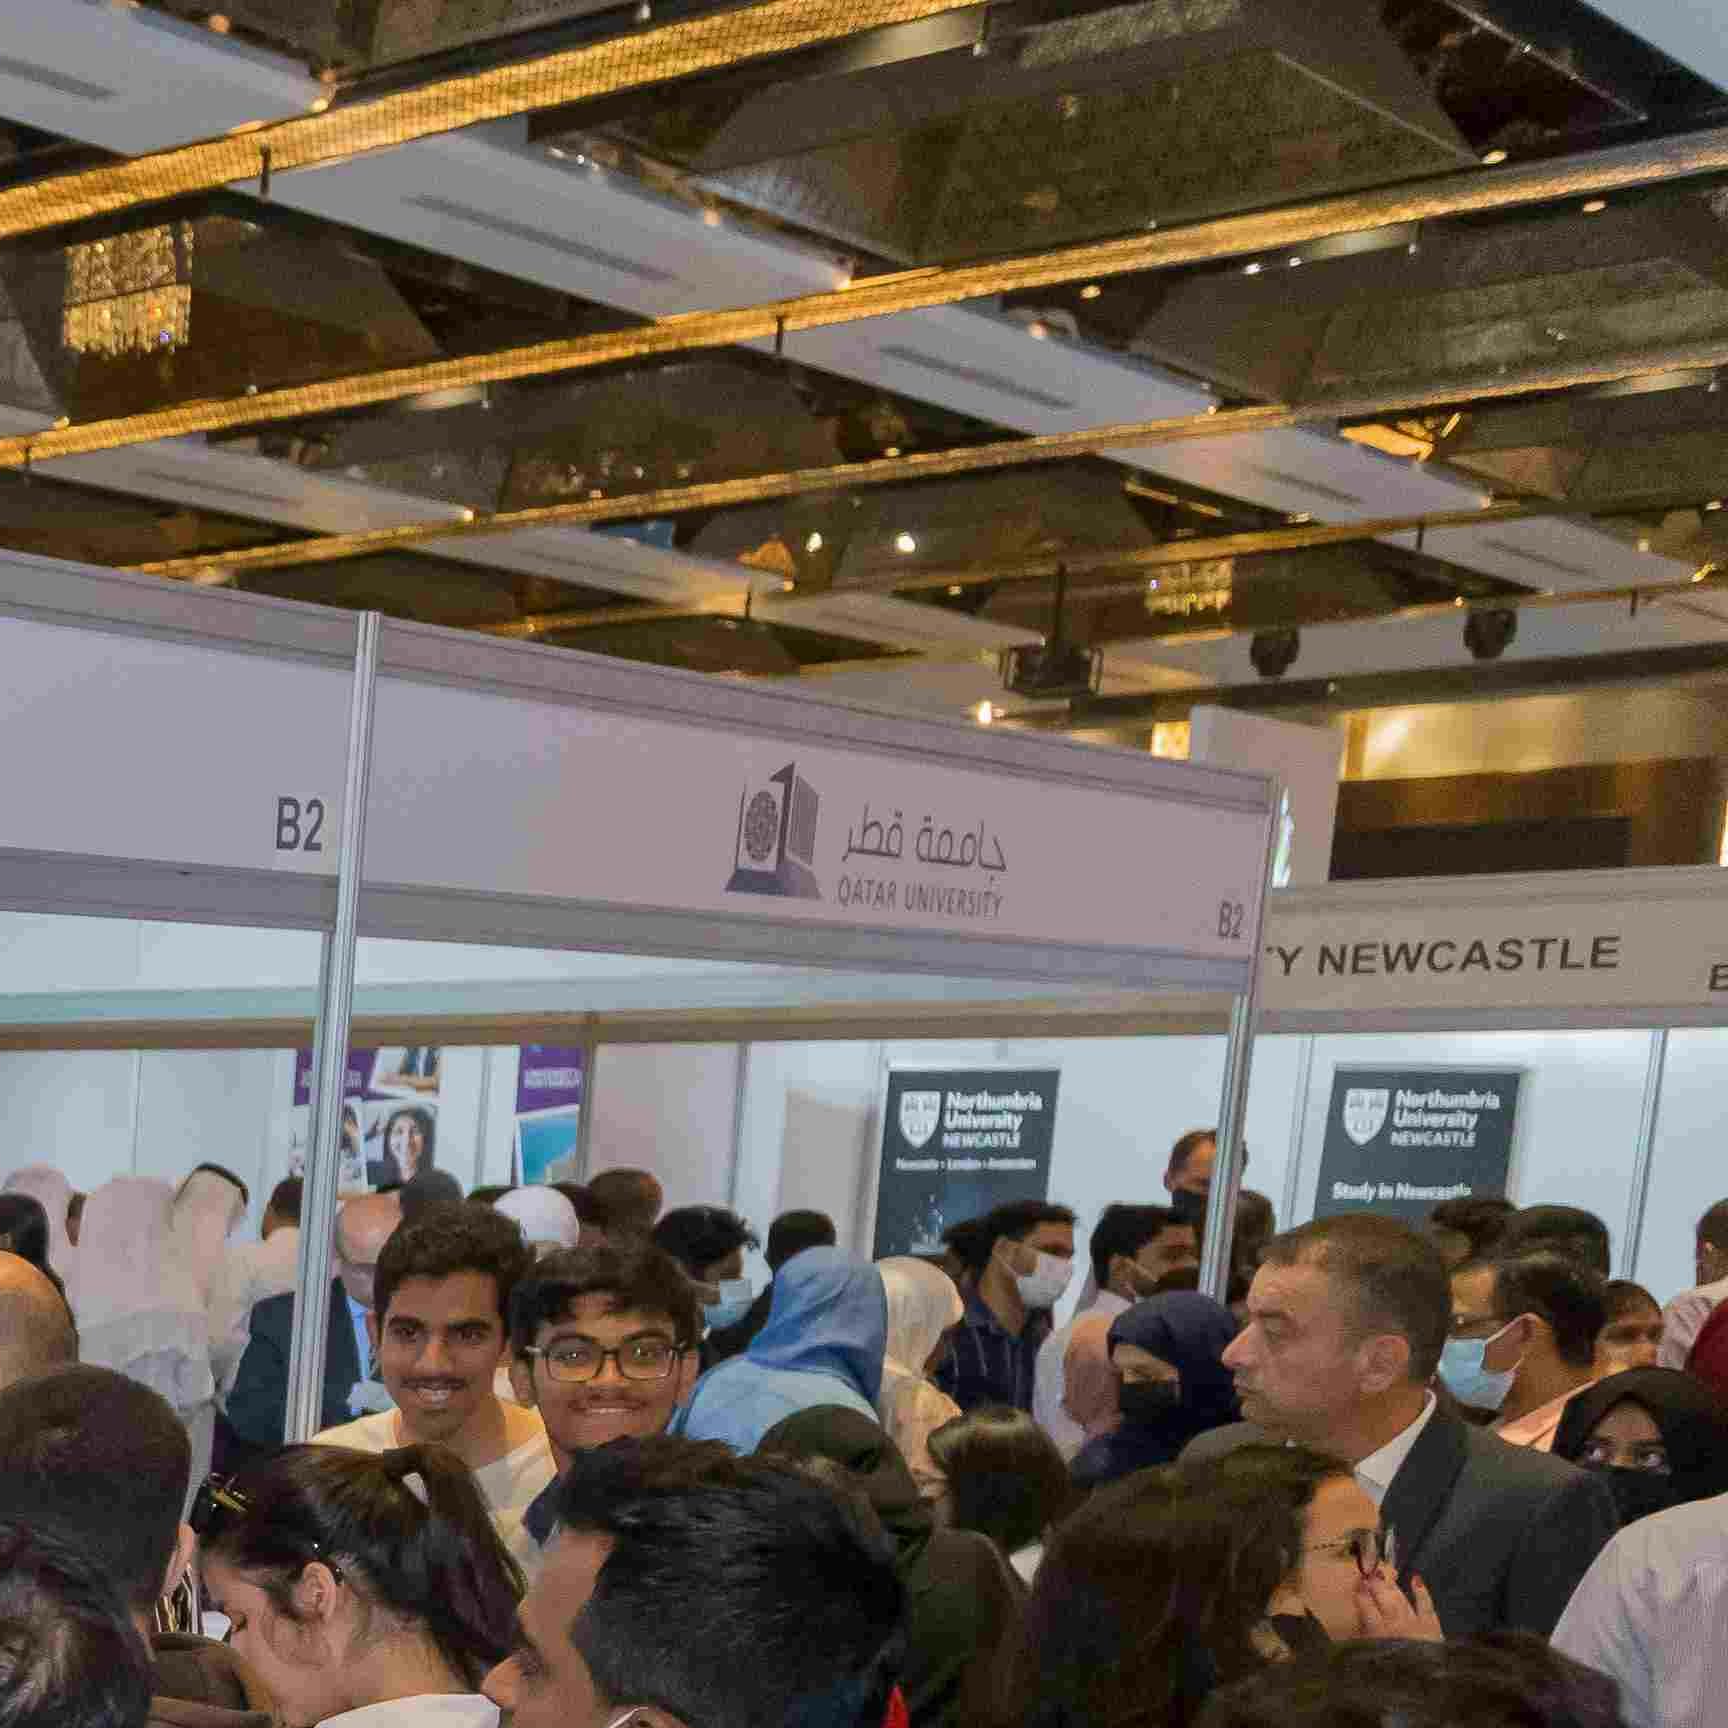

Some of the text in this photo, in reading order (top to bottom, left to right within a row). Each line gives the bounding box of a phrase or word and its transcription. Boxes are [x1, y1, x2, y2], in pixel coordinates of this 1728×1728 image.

[276, 797, 324, 851] B2
[842, 800, 1006, 885] جامعة قطر
[838, 875, 1003, 918] QATAR UNIVERSITY
[1218, 900, 1243, 938] B2
[1318, 935, 1620, 976] NEWCASTLE
[947, 1090, 1042, 1111] Northumbria
[1395, 1088, 1500, 1109] Northumbria
[944, 1111, 1023, 1131] University
[1394, 1110, 1478, 1130] University
[943, 1132, 1020, 1148] NEWCASTLE
[1391, 1131, 1477, 1147] NEWCASTLE
[1333, 1181, 1376, 1203] Study
[1378, 1183, 1394, 1200] in
